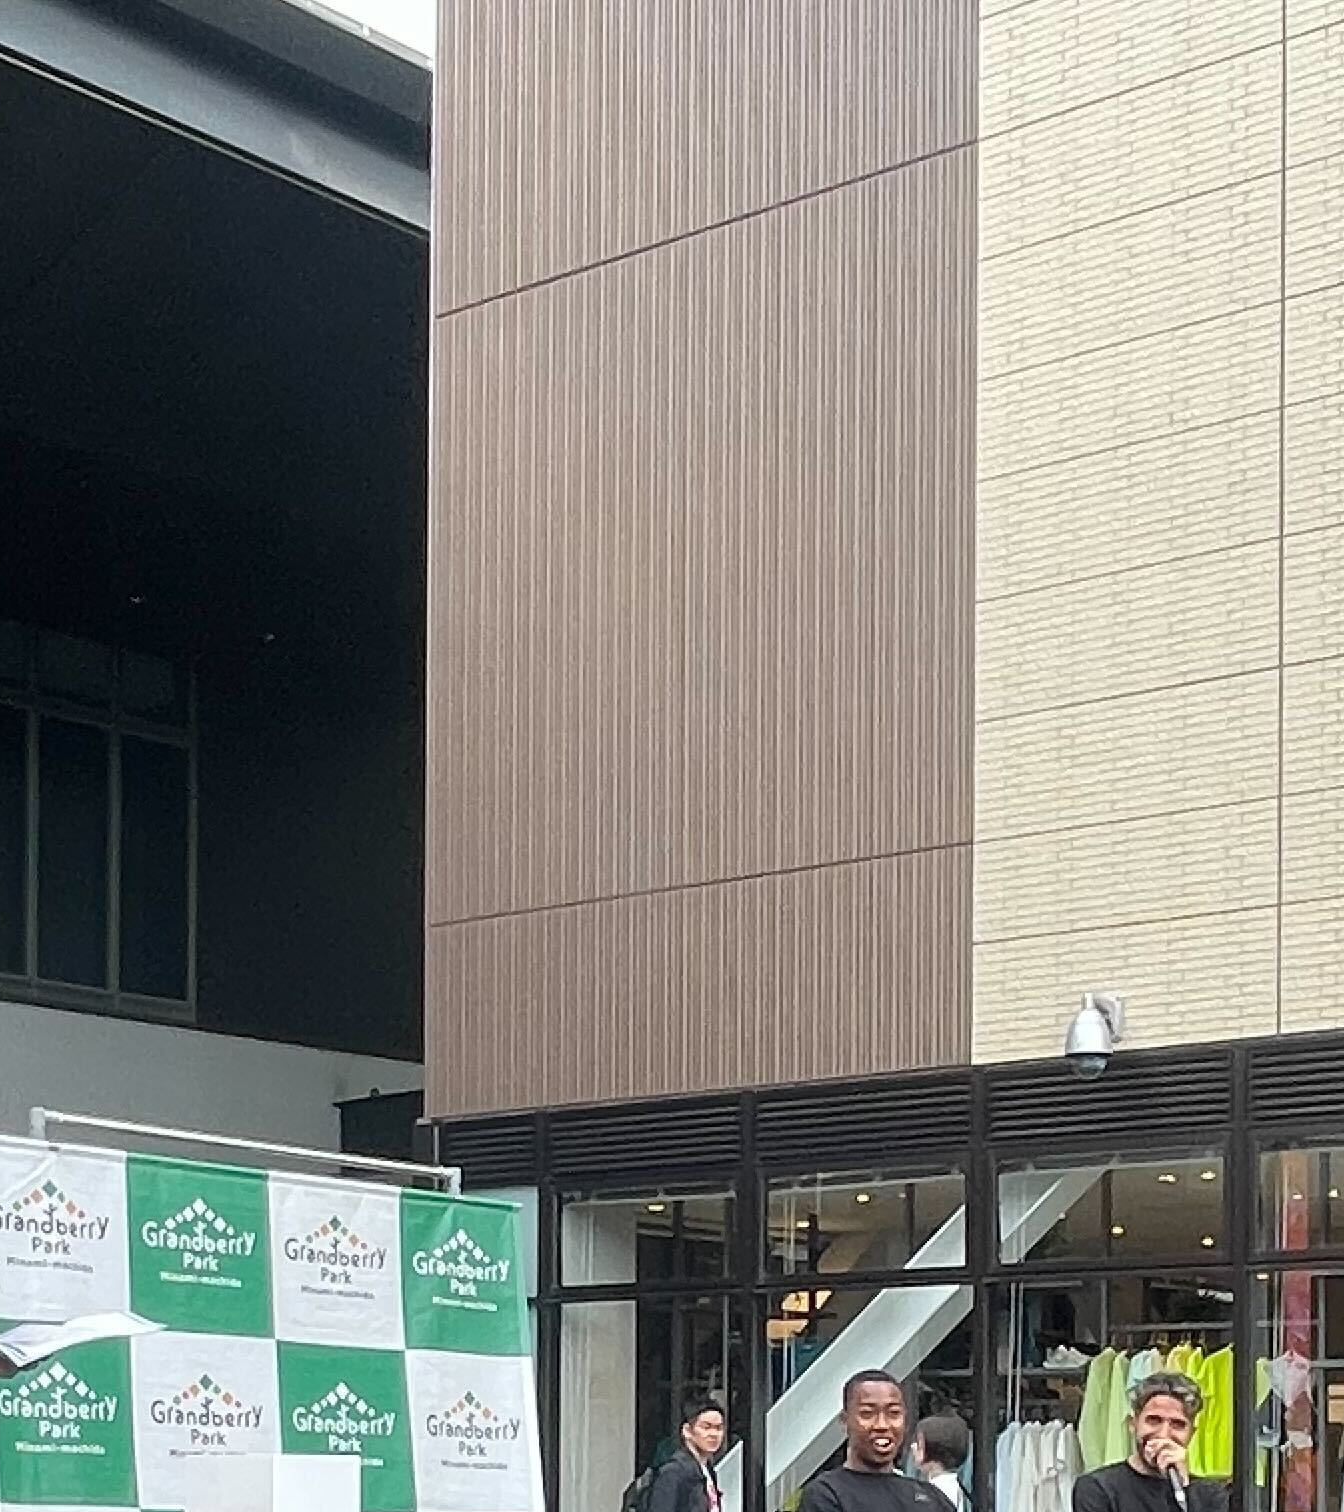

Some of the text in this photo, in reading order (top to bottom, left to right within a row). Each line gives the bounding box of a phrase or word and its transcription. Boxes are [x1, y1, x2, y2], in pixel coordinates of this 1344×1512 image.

[31, 1236, 72, 1256] Park
[142, 1219, 256, 1256] Grandberry
[182, 1252, 219, 1273] Park
[284, 1237, 388, 1270] Grandberry
[412, 1250, 510, 1282] Grandberry
[320, 1266, 353, 1285] Park
[151, 1396, 264, 1429] Grandberry
[292, 1403, 397, 1436] Grandberry
[426, 1412, 520, 1440] Grandberry
[38, 1420, 82, 1439] Park
[190, 1428, 228, 1447] Park
